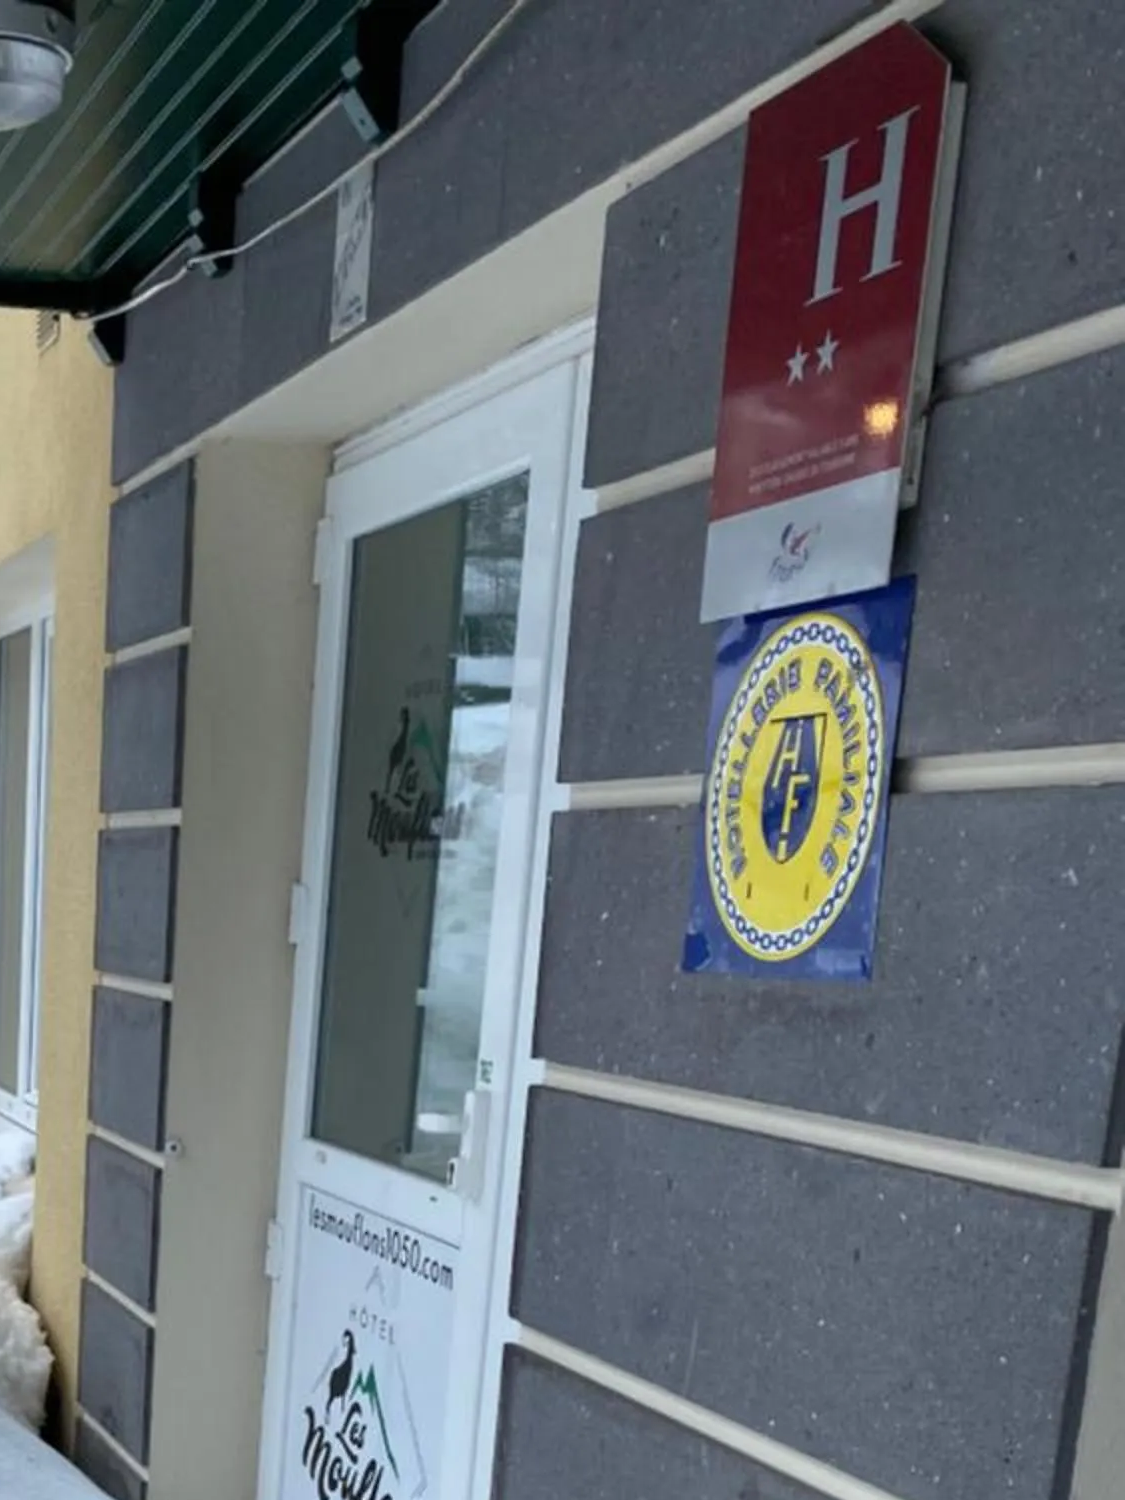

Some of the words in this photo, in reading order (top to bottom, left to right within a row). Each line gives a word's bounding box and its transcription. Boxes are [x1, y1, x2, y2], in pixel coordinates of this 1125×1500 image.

[805, 105, 920, 306] H
[308, 1192, 454, 1292] lesmouflons1050.com
[335, 1401, 367, 1465] Les
